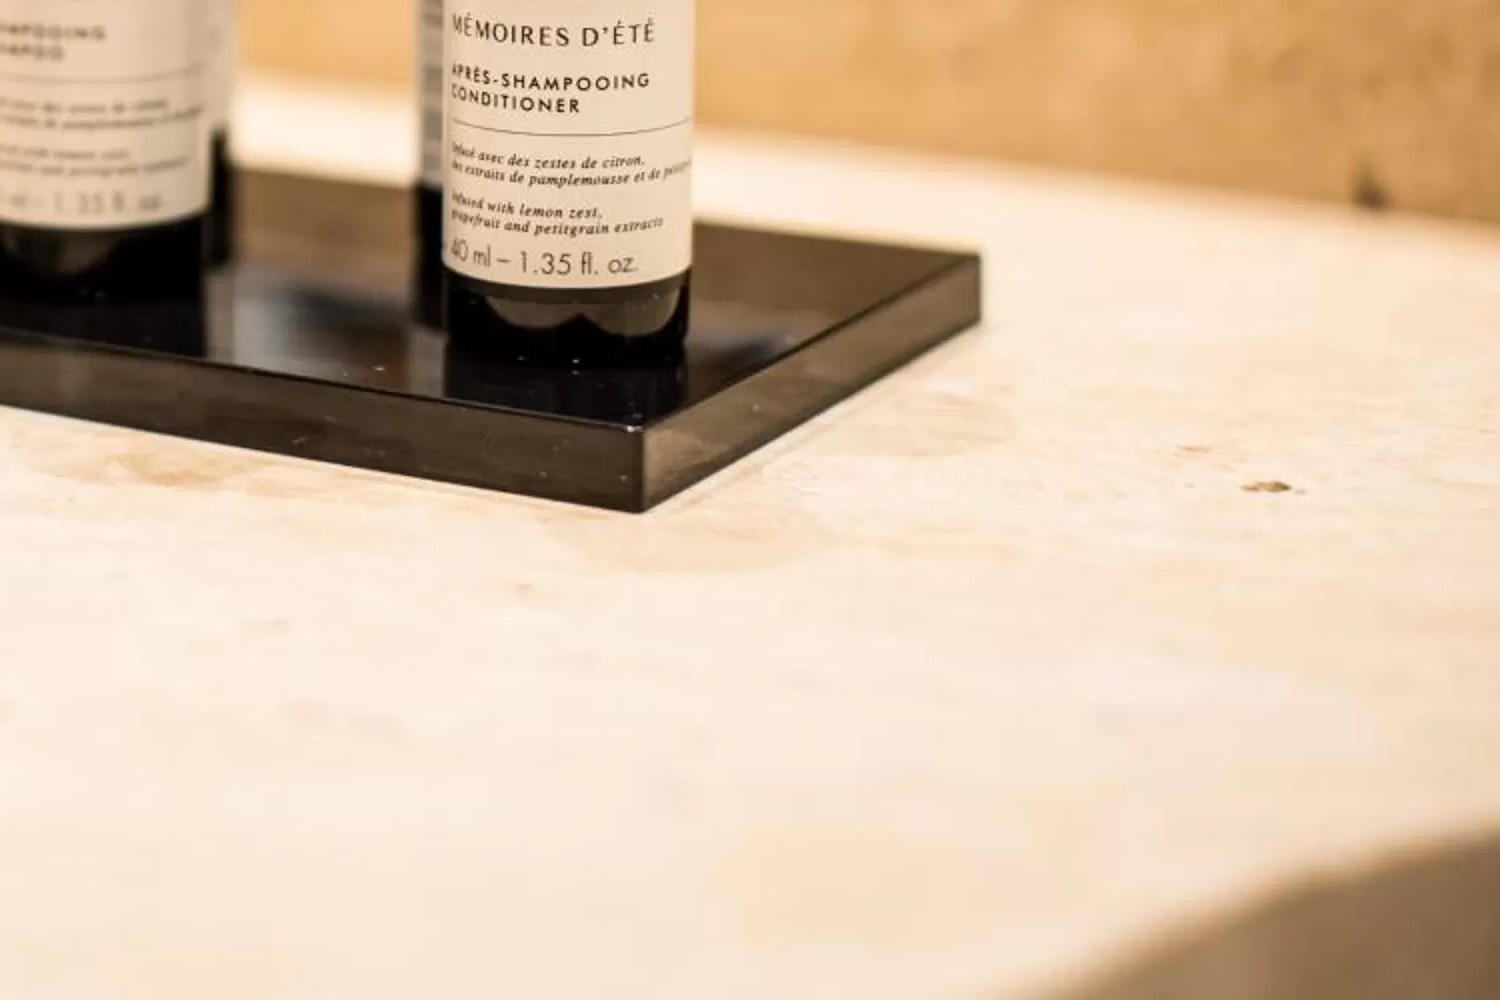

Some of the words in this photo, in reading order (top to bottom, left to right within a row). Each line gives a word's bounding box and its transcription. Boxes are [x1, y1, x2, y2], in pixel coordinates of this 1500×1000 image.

[452, 12, 569, 47] MÉMOIRES
[582, 17, 655, 47] D'ÉTÉ
[451, 63, 649, 91] APRÈS-SHAMPOOING
[451, 84, 580, 113] CONDITIONER
[478, 152, 503, 165] avec
[507, 153, 529, 167] des
[535, 157, 576, 170] zestes
[581, 155, 598, 169] de
[509, 169, 525, 184] de
[528, 170, 629, 189] pamplemousse
[633, 170, 645, 183] et
[487, 200, 515, 216] with
[519, 203, 563, 218] lemon
[504, 218, 530, 233] and
[534, 221, 609, 238] petitgrain
[473, 244, 492, 267] ml
[520, 250, 572, 275] 1.35
